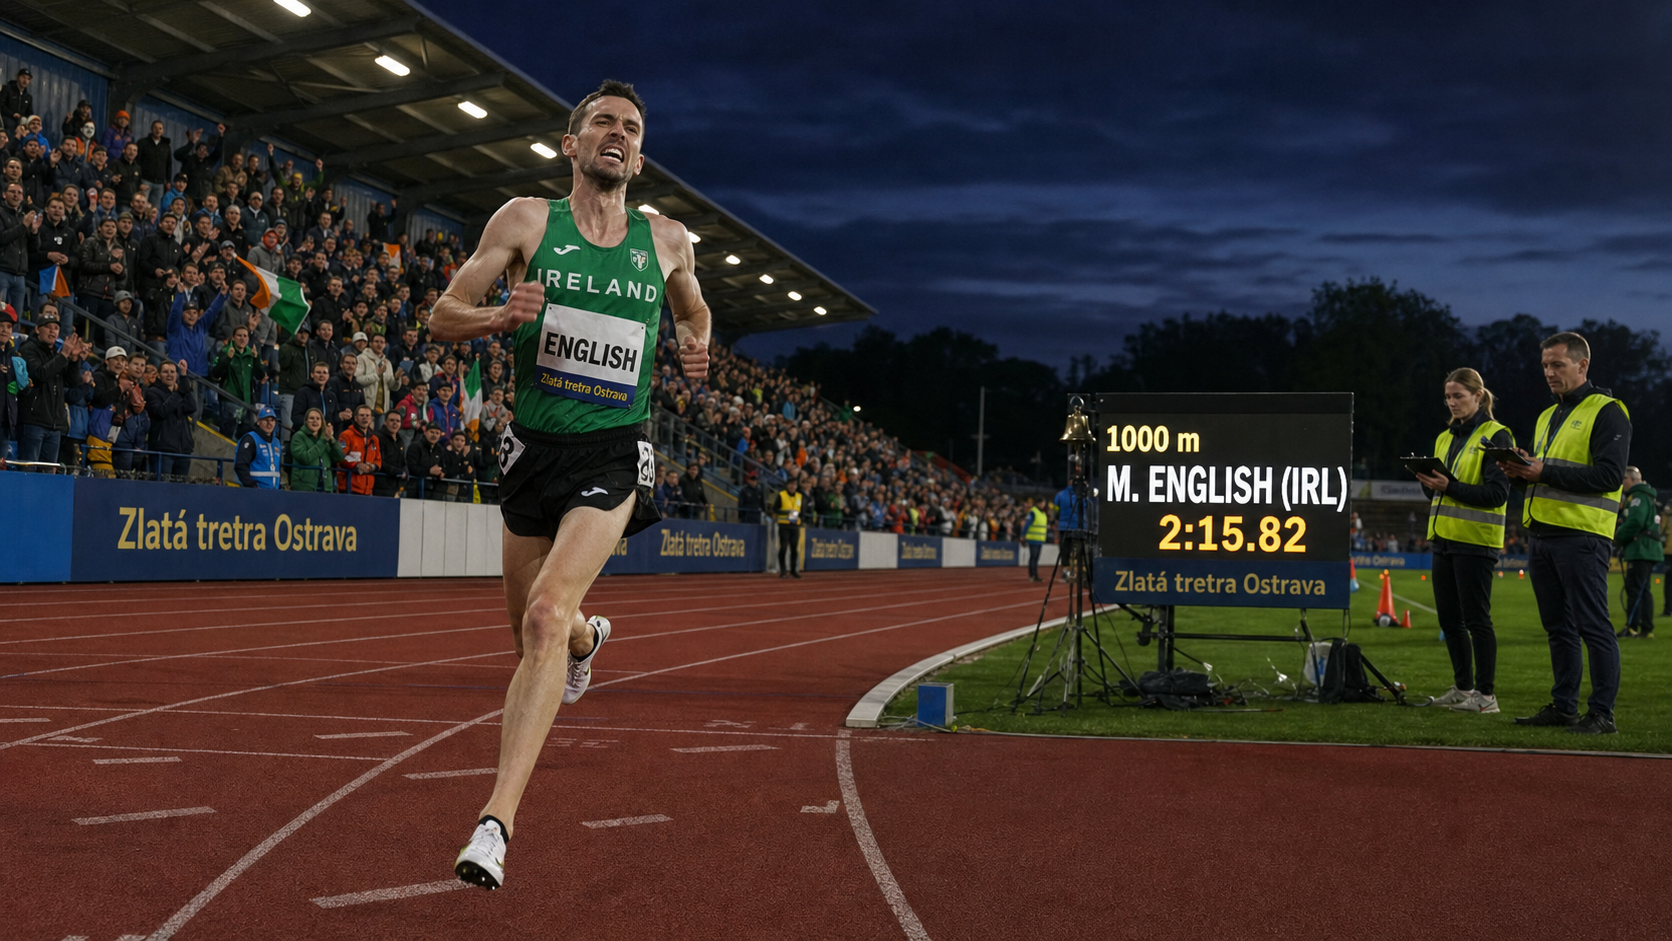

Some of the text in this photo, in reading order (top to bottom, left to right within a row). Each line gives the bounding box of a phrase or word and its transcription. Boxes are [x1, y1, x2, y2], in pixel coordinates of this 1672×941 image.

[537, 268, 657, 303] IRELAND
[543, 331, 638, 373] ENGLISH
[540, 372, 628, 402] Zlatá tretra Ostrava
[1106, 424, 1200, 452] 1000 m
[1106, 465, 1347, 513] M. ENGLISH (IRL)
[117, 506, 357, 552] Zlatá tretra Ostrava
[660, 529, 745, 557] Zlatá tretra Ostrava
[1158, 513, 1307, 553] 2:15.82
[1114, 570, 1326, 595] Zlatá tretra Ostrava
